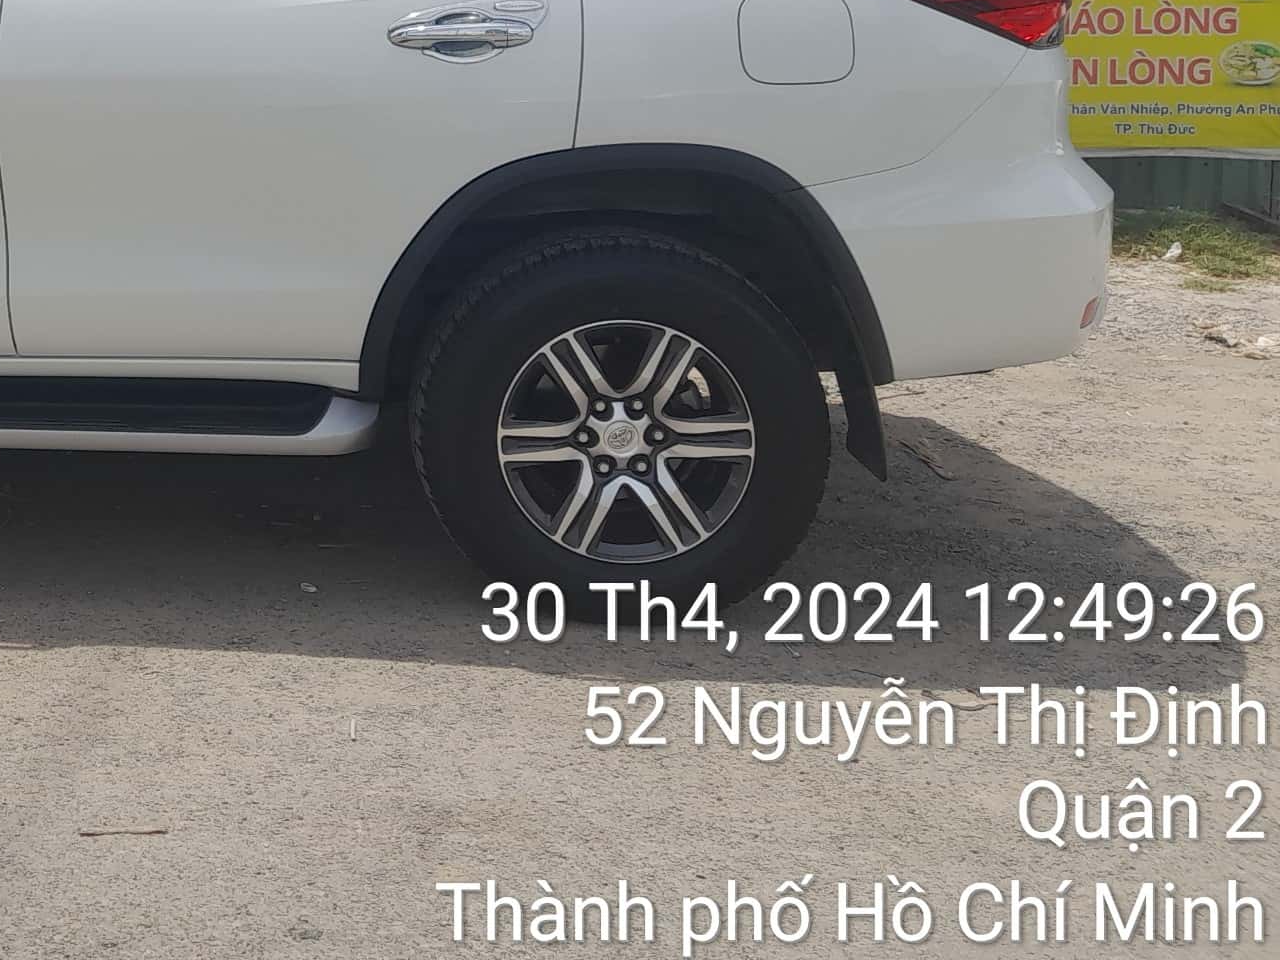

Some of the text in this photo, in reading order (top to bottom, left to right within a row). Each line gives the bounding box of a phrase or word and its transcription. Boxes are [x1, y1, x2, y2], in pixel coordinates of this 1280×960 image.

[1134, 0, 1238, 35] LÒNG
[1108, 50, 1212, 86] LÒNG
[1177, 103, 1232, 117] Phường
[1236, 103, 1255, 115] An
